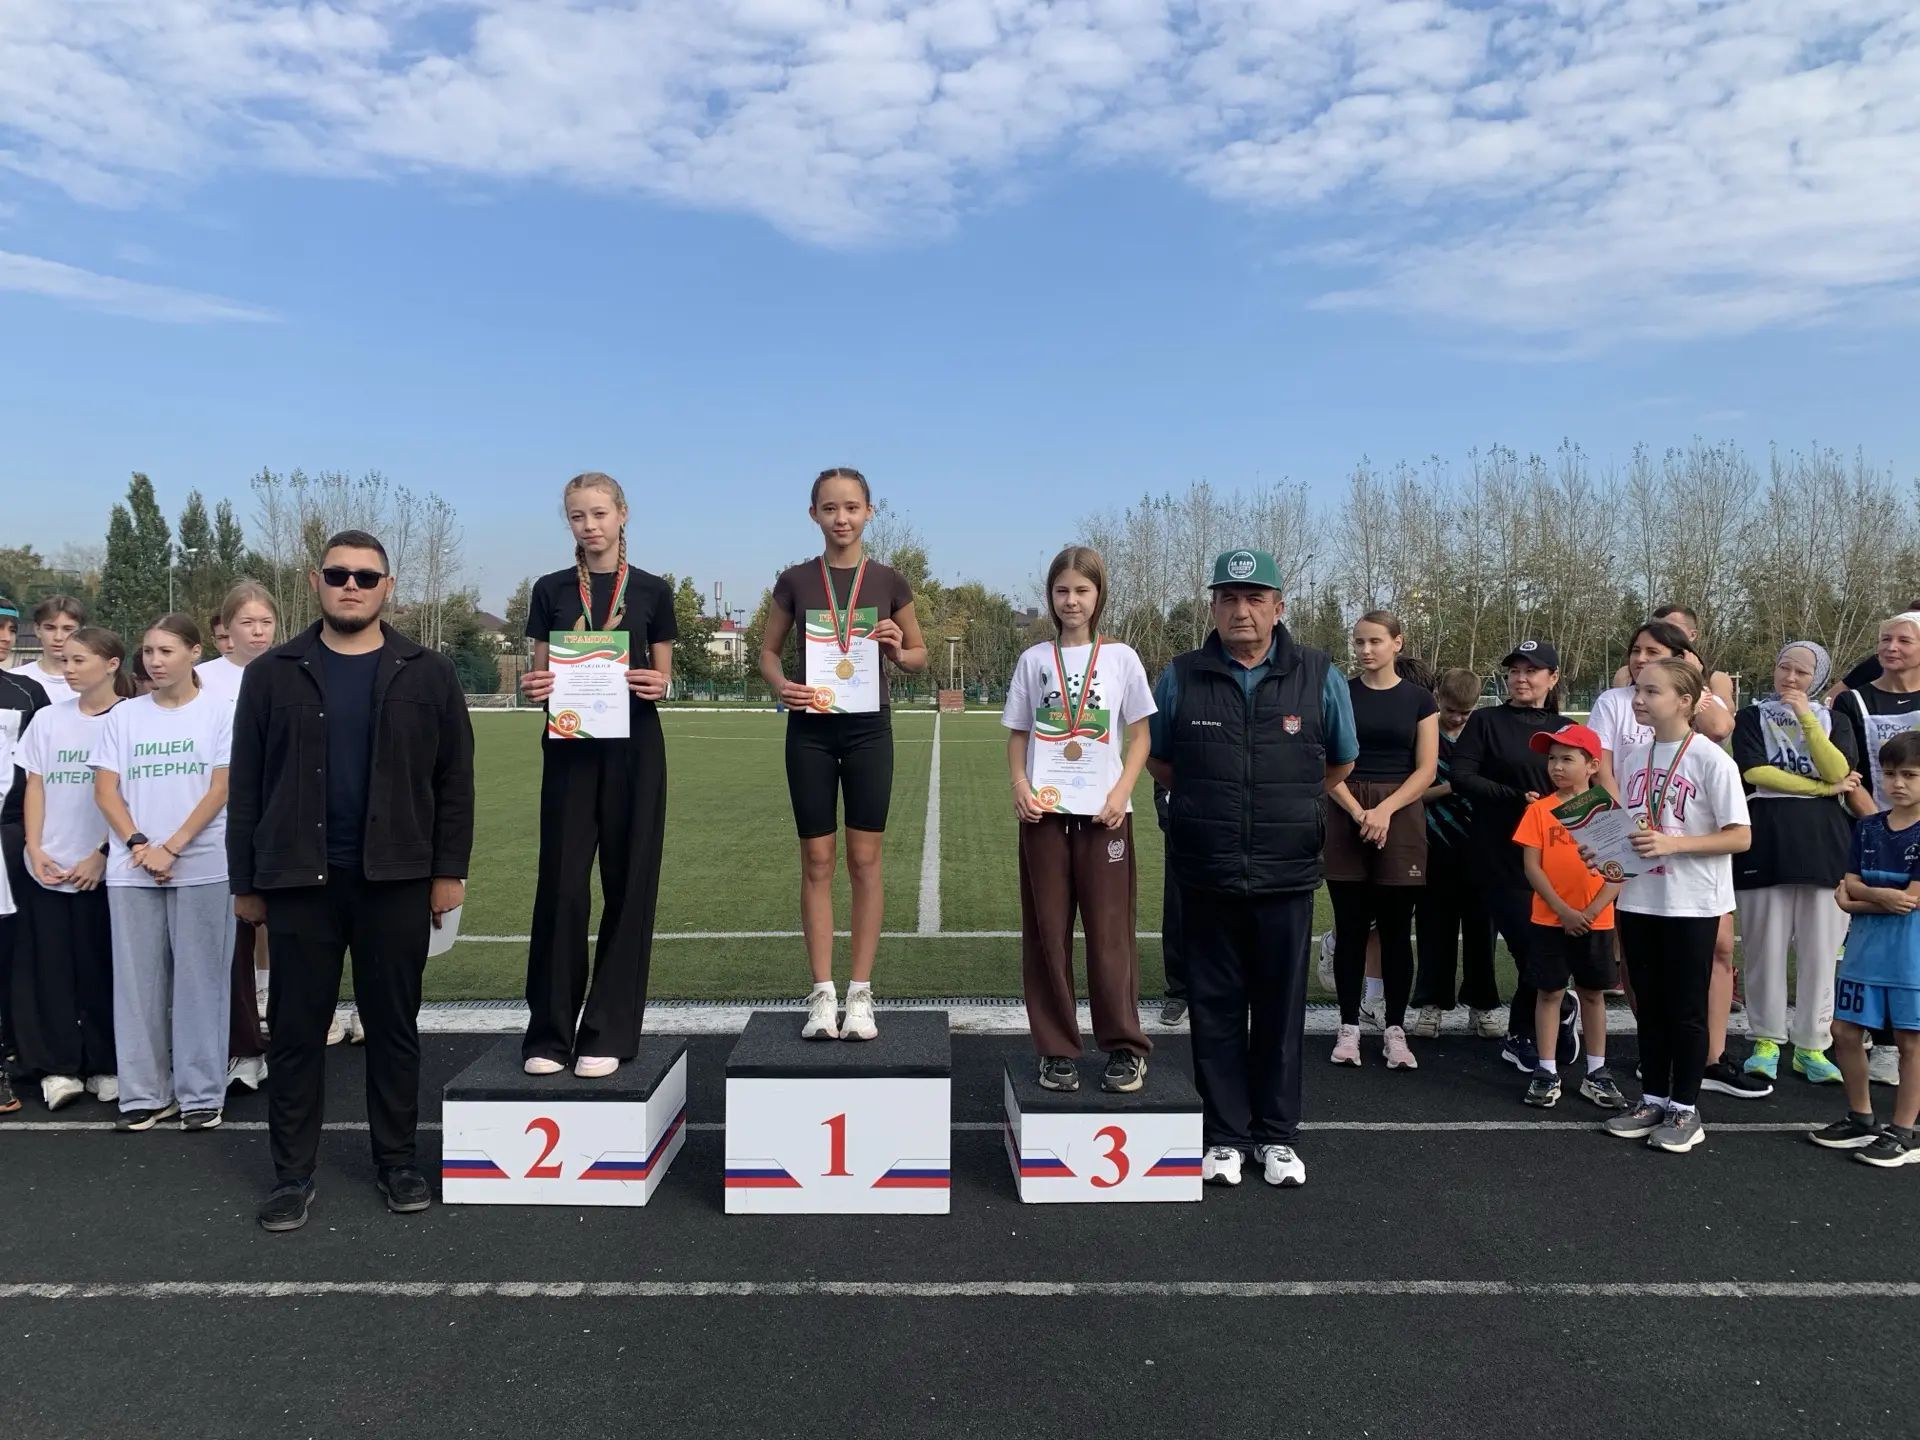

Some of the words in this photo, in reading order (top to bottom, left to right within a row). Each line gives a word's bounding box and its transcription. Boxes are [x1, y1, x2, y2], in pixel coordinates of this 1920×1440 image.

[1049, 711, 1097, 722] ГРАТА
[57, 750, 91, 763] ЛИЦ
[134, 738, 194, 757] ЛИЦЕЙ
[523, 1117, 564, 1179] 2
[820, 1112, 855, 1177] 1
[1089, 1125, 1130, 1188] 3
